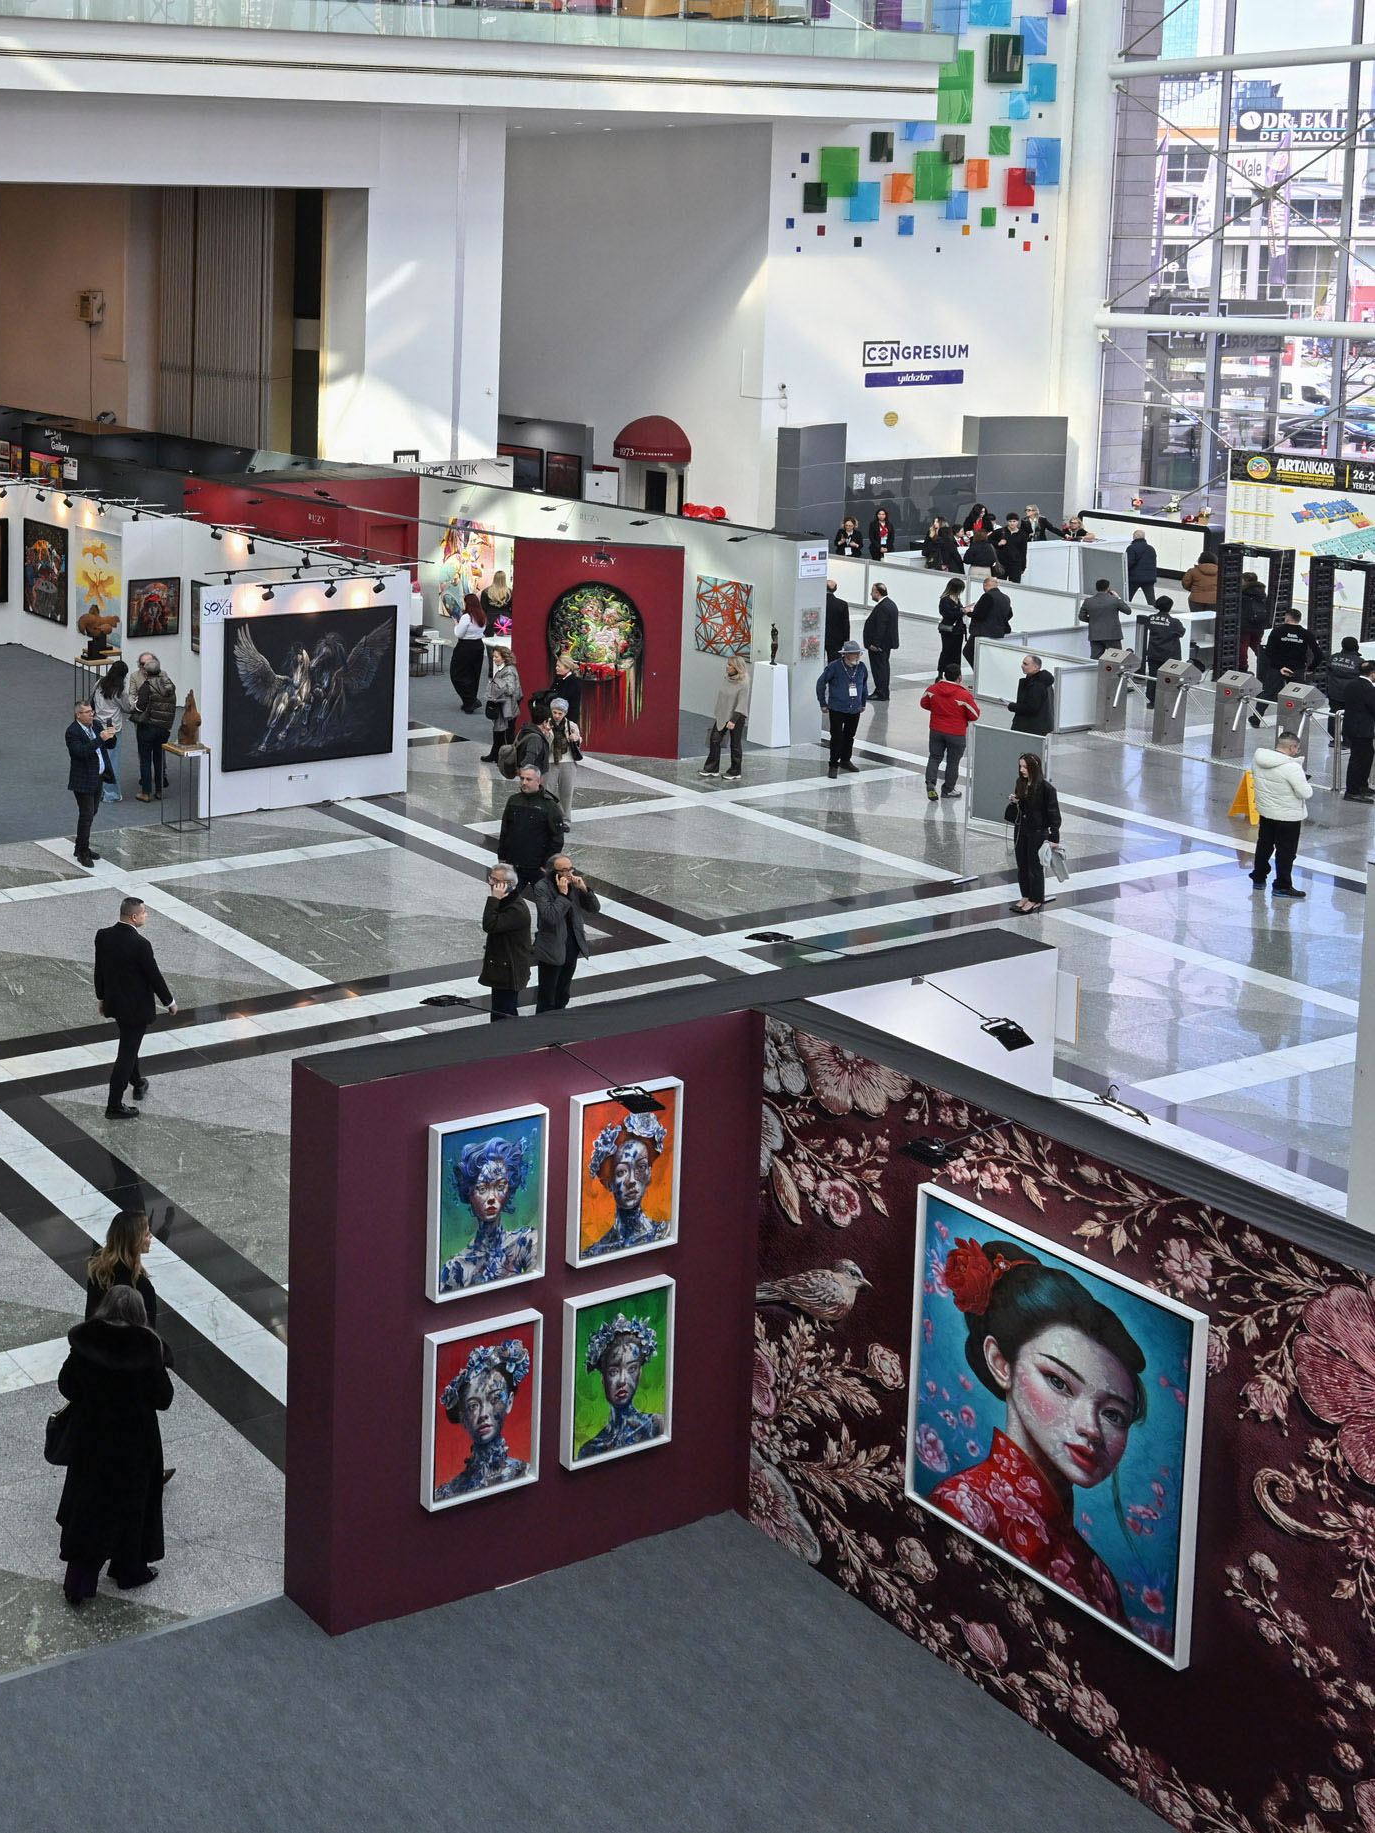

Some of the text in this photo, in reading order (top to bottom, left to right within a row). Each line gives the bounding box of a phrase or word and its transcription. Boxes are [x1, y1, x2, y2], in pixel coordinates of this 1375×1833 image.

[1241, 159, 1262, 177] Kale
[867, 344, 969, 361] CONGRESIUM
[447, 462, 478, 476] ANTİK
[1276, 457, 1336, 476] ARTANKARA
